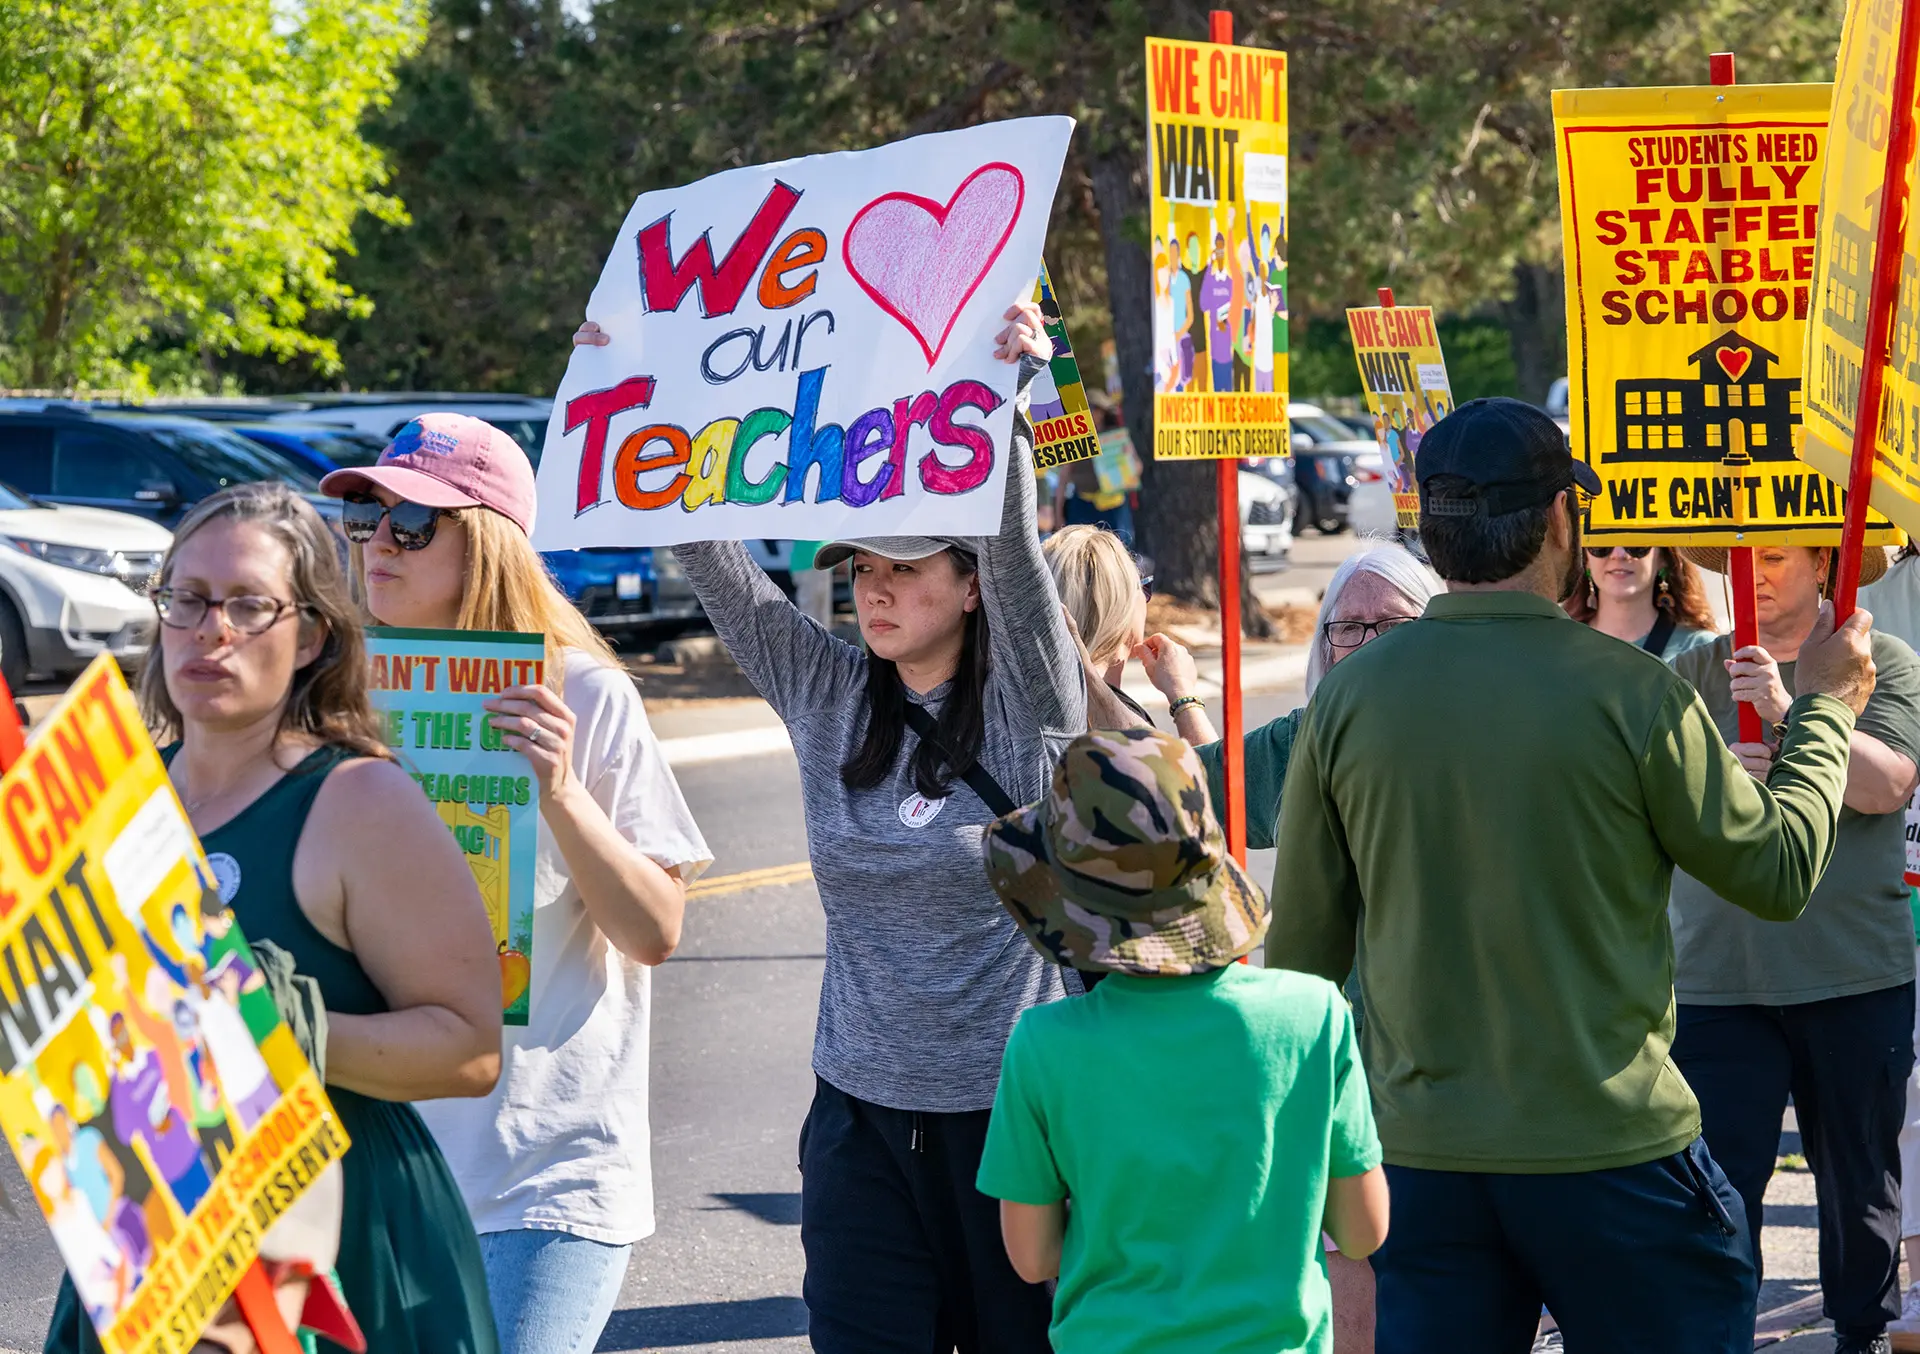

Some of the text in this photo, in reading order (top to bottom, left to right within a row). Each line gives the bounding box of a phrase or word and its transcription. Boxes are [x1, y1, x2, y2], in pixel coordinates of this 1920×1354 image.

[1151, 45, 1284, 122] WE CAN'T
[1155, 124, 1238, 202] WAIT
[1628, 133, 1818, 167] STUDENTS NEED
[1636, 165, 1810, 204] FULLY
[636, 179, 828, 319] We
[1614, 246, 1814, 285] STABLE
[1601, 286, 1809, 325] SCHOOL
[700, 309, 835, 385] our
[1349, 309, 1434, 348] WE CAN'T
[1358, 352, 1415, 392] WAIT
[1160, 396, 1284, 424] INVEST IN THE SCHOOLS
[563, 365, 1006, 519] Teachers
[1032, 414, 1089, 446] HOOLS
[1158, 429, 1182, 456] OUR
[1185, 429, 1241, 455] STUDENTS
[1244, 429, 1287, 454] DESERVE
[1608, 478, 1657, 520] WE
[1669, 475, 1761, 519] CAN'T
[1398, 512, 1415, 526] OUR
[368, 655, 440, 692] AN'T
[411, 711, 472, 750] THE
[6, 671, 136, 876] CAN'T
[113, 1086, 319, 1350] INVEST IN THE SCHOOLS
[170, 1120, 342, 1347] STUDENTS DESERVE
